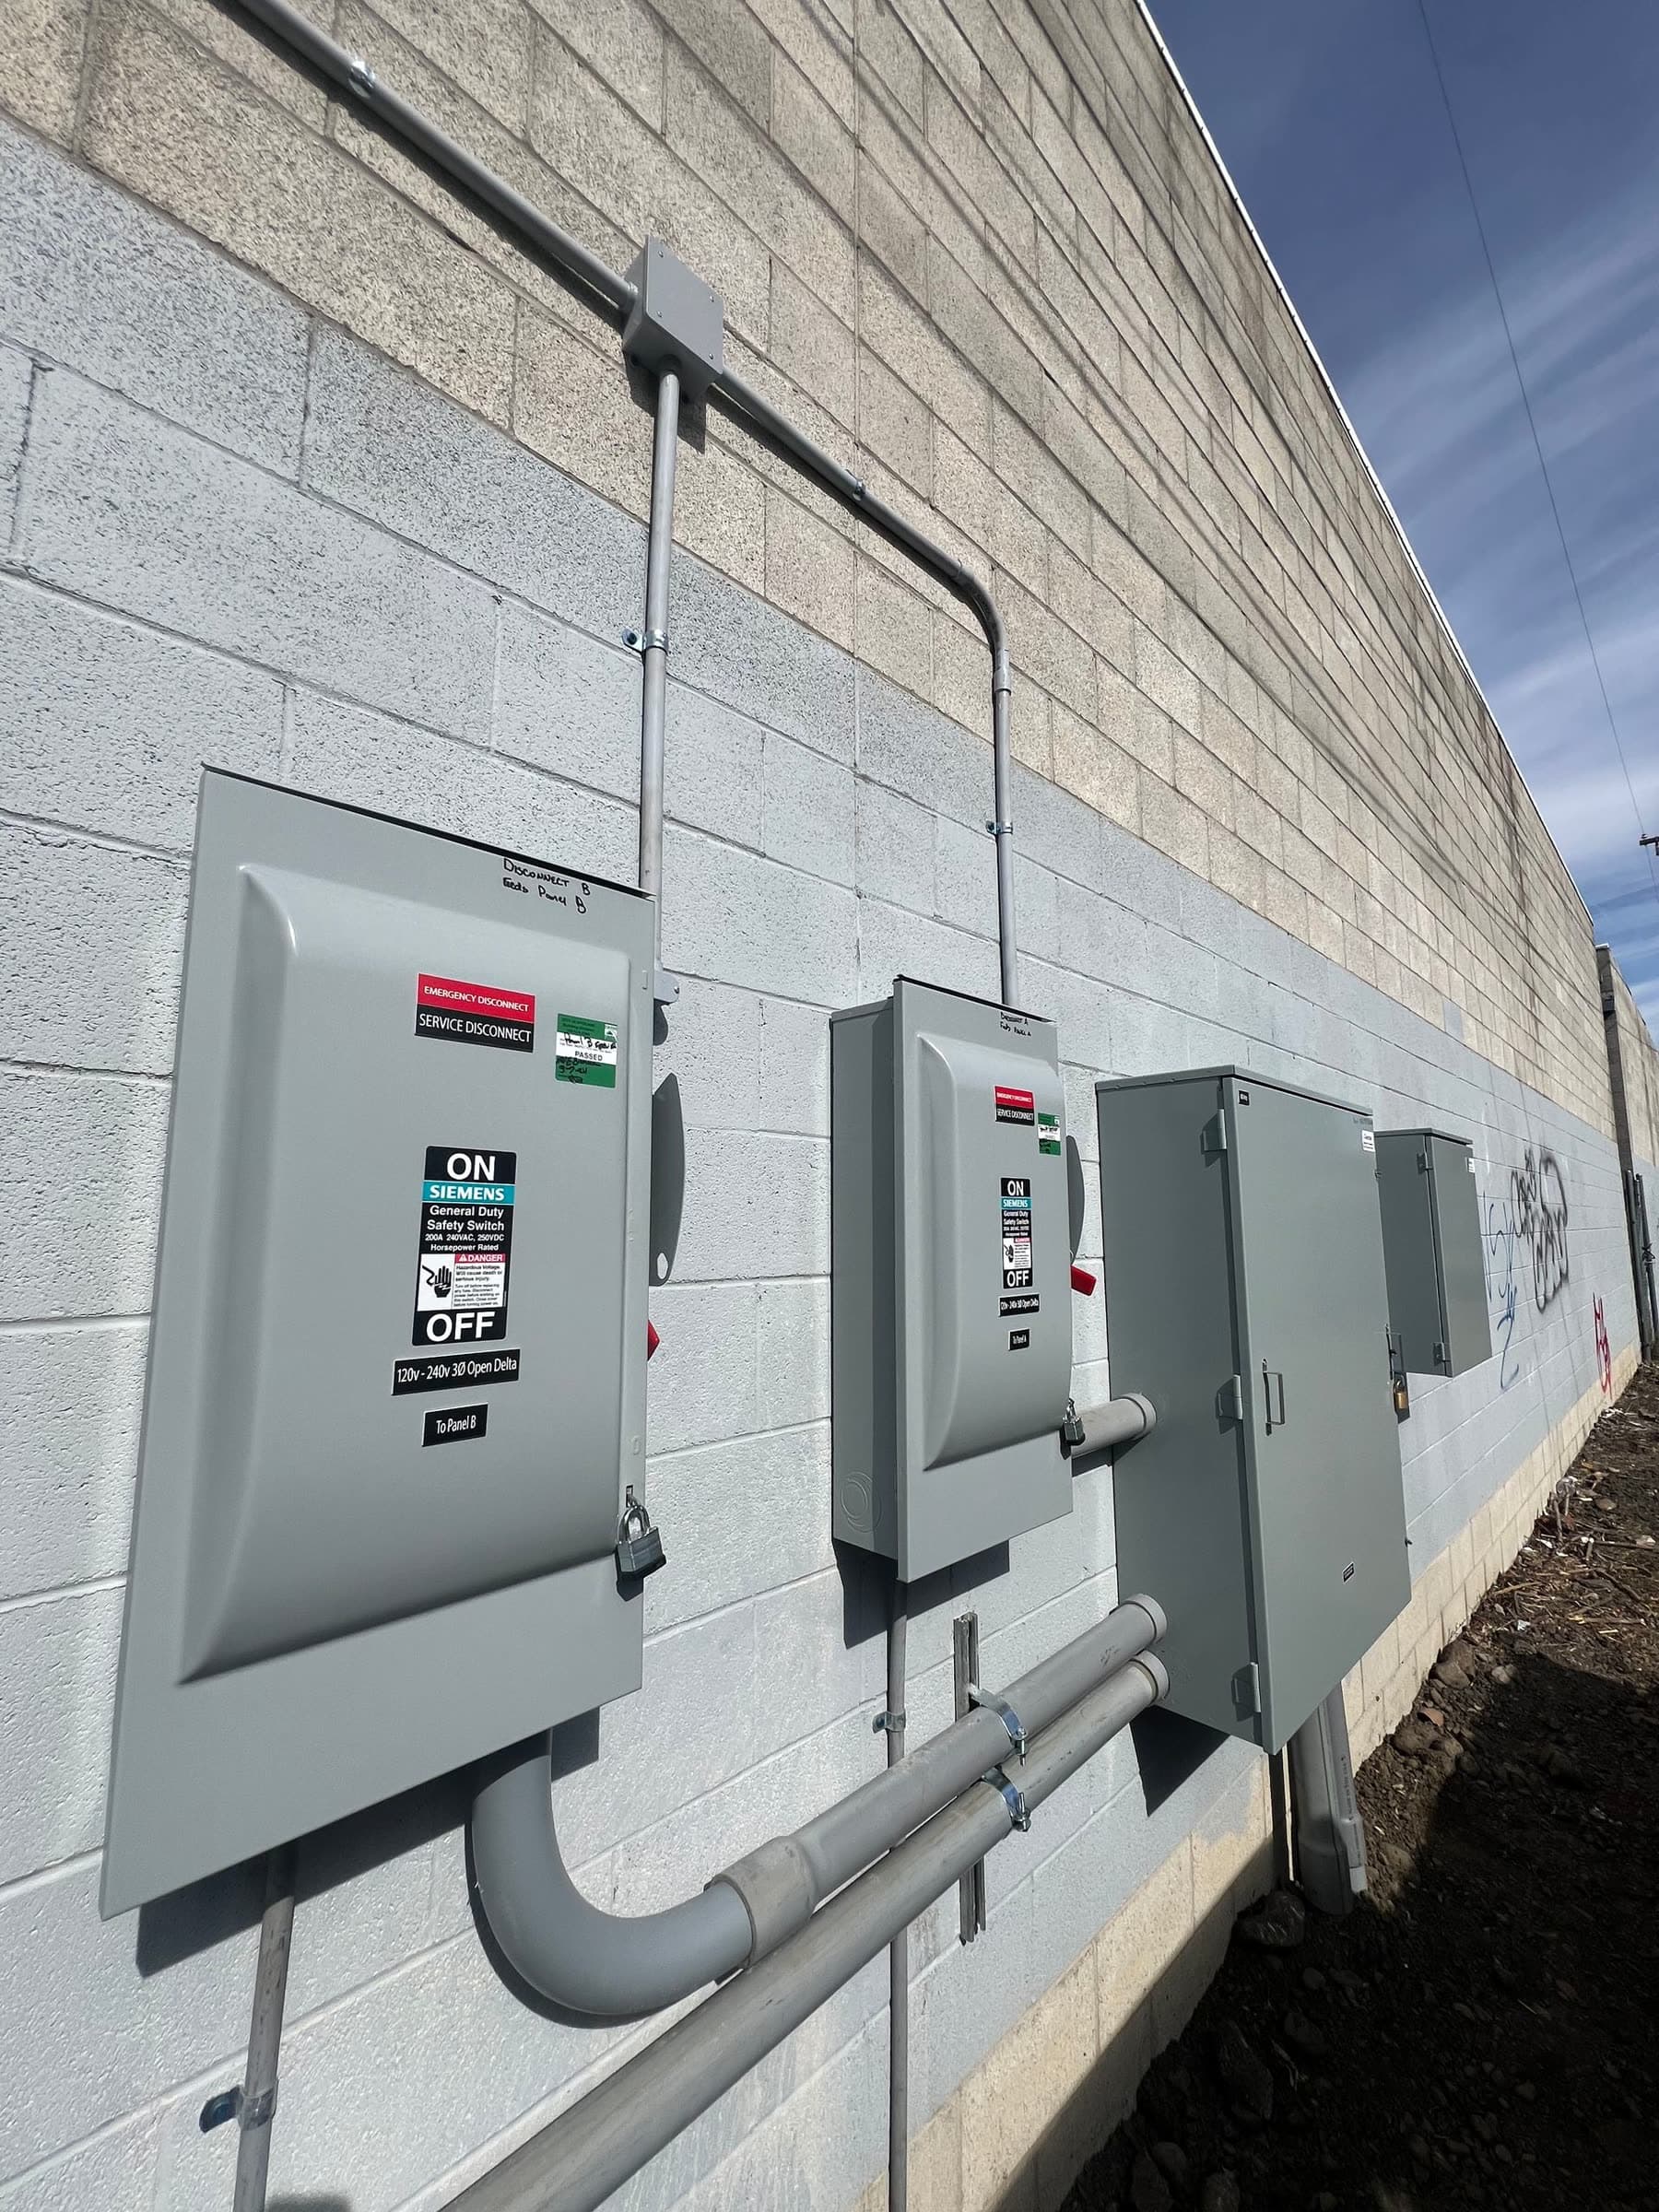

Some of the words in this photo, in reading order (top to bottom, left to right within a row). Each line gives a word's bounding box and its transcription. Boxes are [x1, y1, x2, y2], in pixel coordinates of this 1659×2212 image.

[581, 882, 591, 896] B
[424, 985, 477, 1003] EMERGENCY
[477, 995, 529, 1012] DISCONNECT
[418, 1013, 464, 1032] SERVICE
[465, 1020, 532, 1042] DISCONNECT
[574, 1051, 604, 1062] PASSED
[446, 1153, 496, 1181] ON
[429, 1184, 504, 1201] SIEMENS
[1006, 1180, 1024, 1196] ON
[1003, 1199, 1029, 1207] SIEMENS
[429, 1205, 475, 1217] General
[478, 1206, 504, 1219] Duty
[427, 1218, 465, 1233] Safety
[466, 1219, 505, 1231] Switch
[425, 1233, 443, 1241] 200A
[446, 1233, 476, 1242] 240VAC,
[477, 1233, 505, 1241] 250VDC
[430, 1243, 476, 1253] Horsepower
[477, 1243, 499, 1252] Rated
[467, 1253, 503, 1262] DANGER
[1006, 1269, 1030, 1288] OFF
[426, 1311, 496, 1342] OFF
[397, 1367, 420, 1382] 120v
[426, 1364, 451, 1380] 240v
[467, 1360, 492, 1378] Open
[493, 1356, 517, 1372] Delta
[436, 1419, 447, 1434] To
[447, 1415, 469, 1433] Panel
[470, 1414, 477, 1429] B
